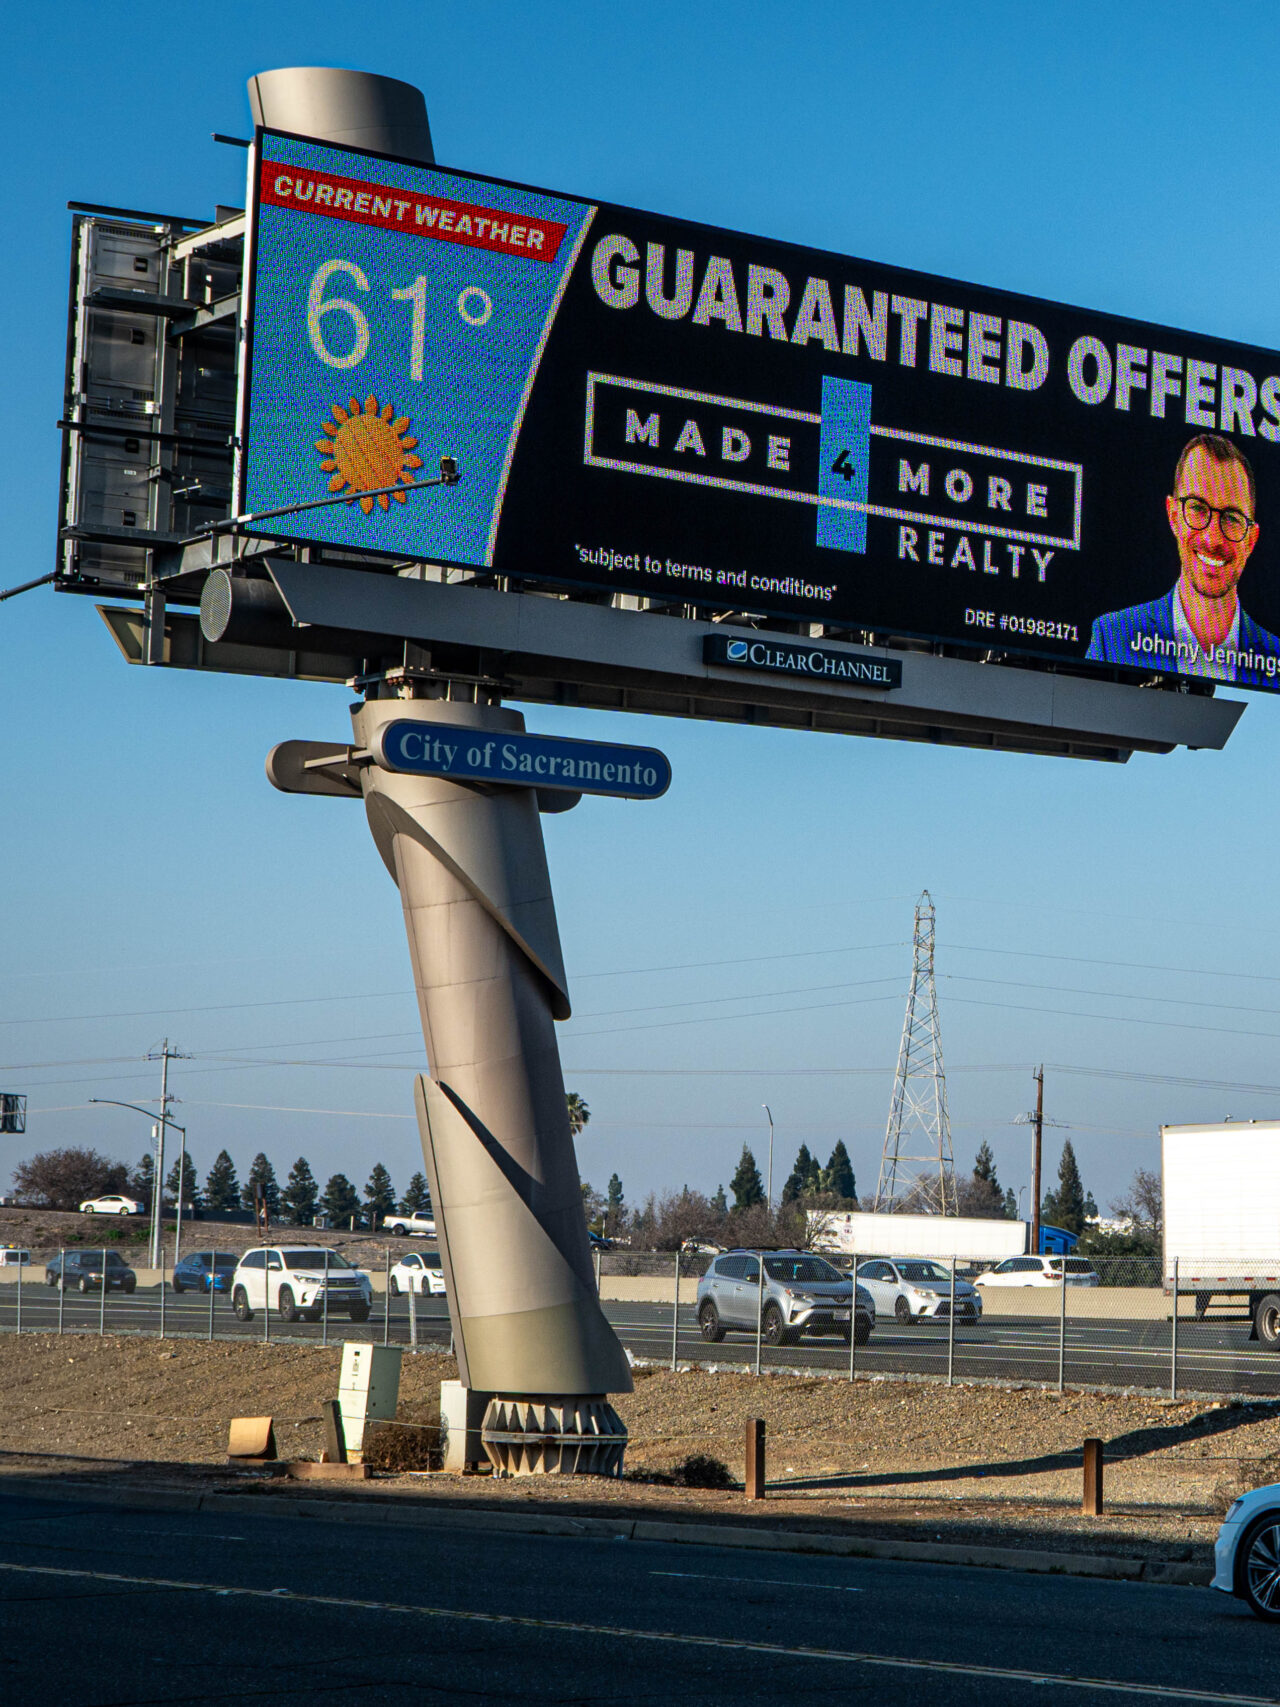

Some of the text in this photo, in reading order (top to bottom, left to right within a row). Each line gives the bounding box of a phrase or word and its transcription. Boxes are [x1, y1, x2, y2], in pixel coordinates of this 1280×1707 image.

[273, 174, 545, 251] CURRENT WEATHER
[590, 232, 1050, 392] GUARANTEED
[624, 407, 1049, 518] MADE 4 MORE
[644, 554, 662, 575] to
[665, 558, 713, 584] terms
[716, 568, 747, 588] and
[898, 525, 1055, 583] REALTY
[964, 607, 1079, 642] DRE #01982171
[1130, 631, 1200, 664] Johnny
[399, 731, 658, 788] City of Sacramento
